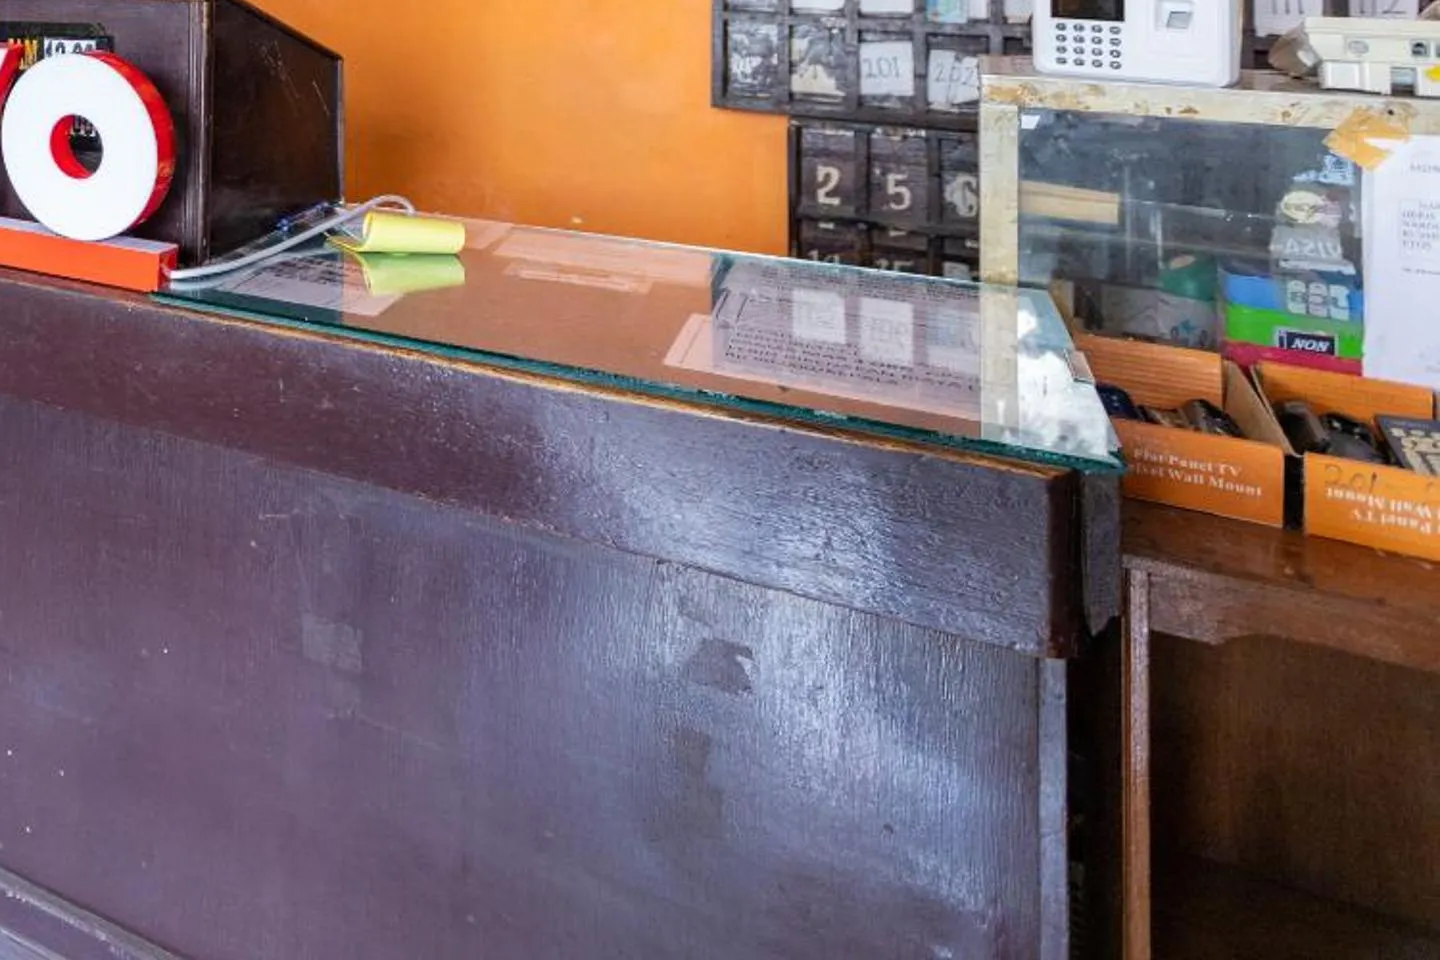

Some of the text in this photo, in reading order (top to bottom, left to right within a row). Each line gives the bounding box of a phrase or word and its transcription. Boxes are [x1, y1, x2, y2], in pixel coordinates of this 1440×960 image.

[816, 165, 841, 206] 2
[887, 173, 911, 210] 5
[1168, 453, 1212, 474] Panel
[1215, 462, 1243, 478] TV
[1167, 468, 1205, 486] Wall
[1208, 474, 1263, 497] Mount
